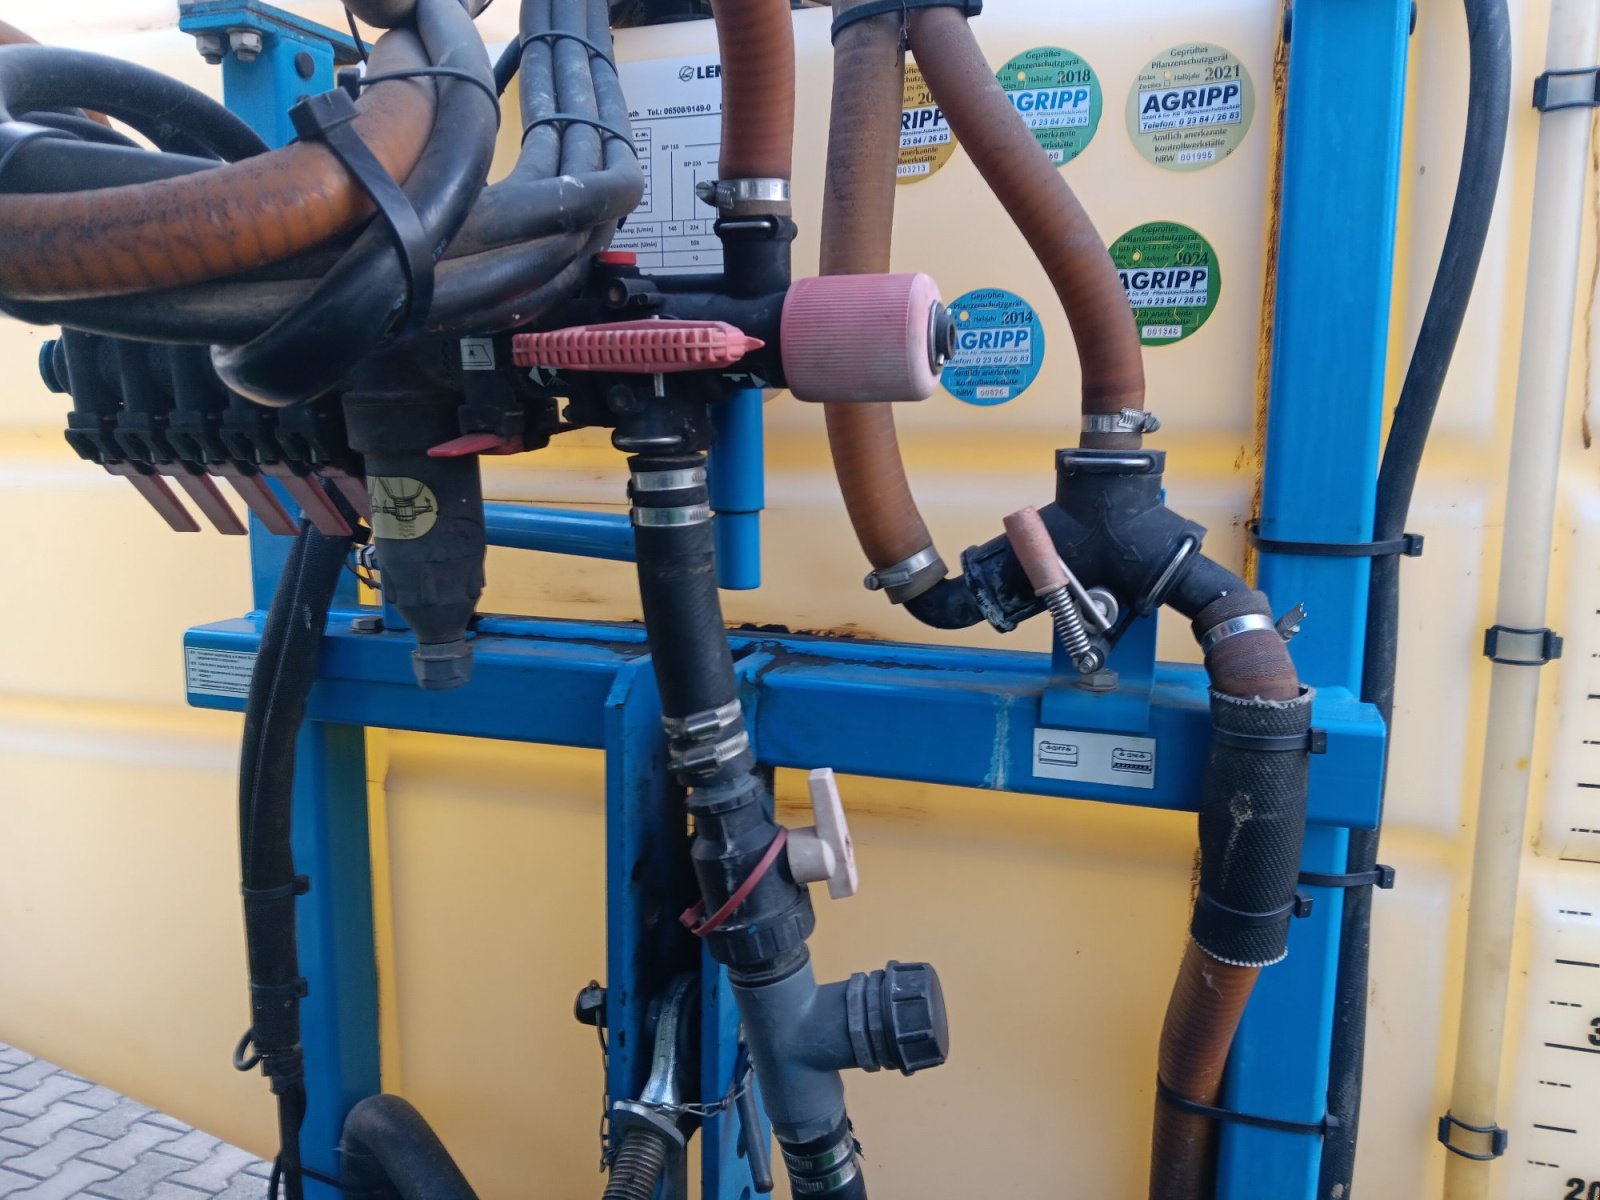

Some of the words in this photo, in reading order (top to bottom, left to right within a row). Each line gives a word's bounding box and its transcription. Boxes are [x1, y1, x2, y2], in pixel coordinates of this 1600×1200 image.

[1026, 51, 1061, 61] Geprüftes
[1171, 46, 1208, 57] Geprüftes
[1007, 59, 1079, 70] Pflanzenschutzgerät
[1151, 54, 1228, 69] Pflanzenschutzgerät
[1057, 69, 1091, 84] 2018
[1205, 64, 1239, 80] 2021
[1142, 84, 1239, 114] AGRIPP
[664, 104, 711, 114] 06508/9149-0
[1143, 120, 1177, 130] Telefon:
[1036, 130, 1075, 138] anerkannte
[1152, 132, 1181, 141] Amtlich
[1184, 129, 1227, 139] anerkannte
[901, 147, 938, 156] anerkannte
[1154, 140, 1225, 152] Kontrollwerkstätte
[1155, 155, 1175, 163] NRW
[1174, 252, 1209, 266] 2024
[971, 292, 1004, 300] Geprüftes
[1002, 311, 1033, 325] 2014
